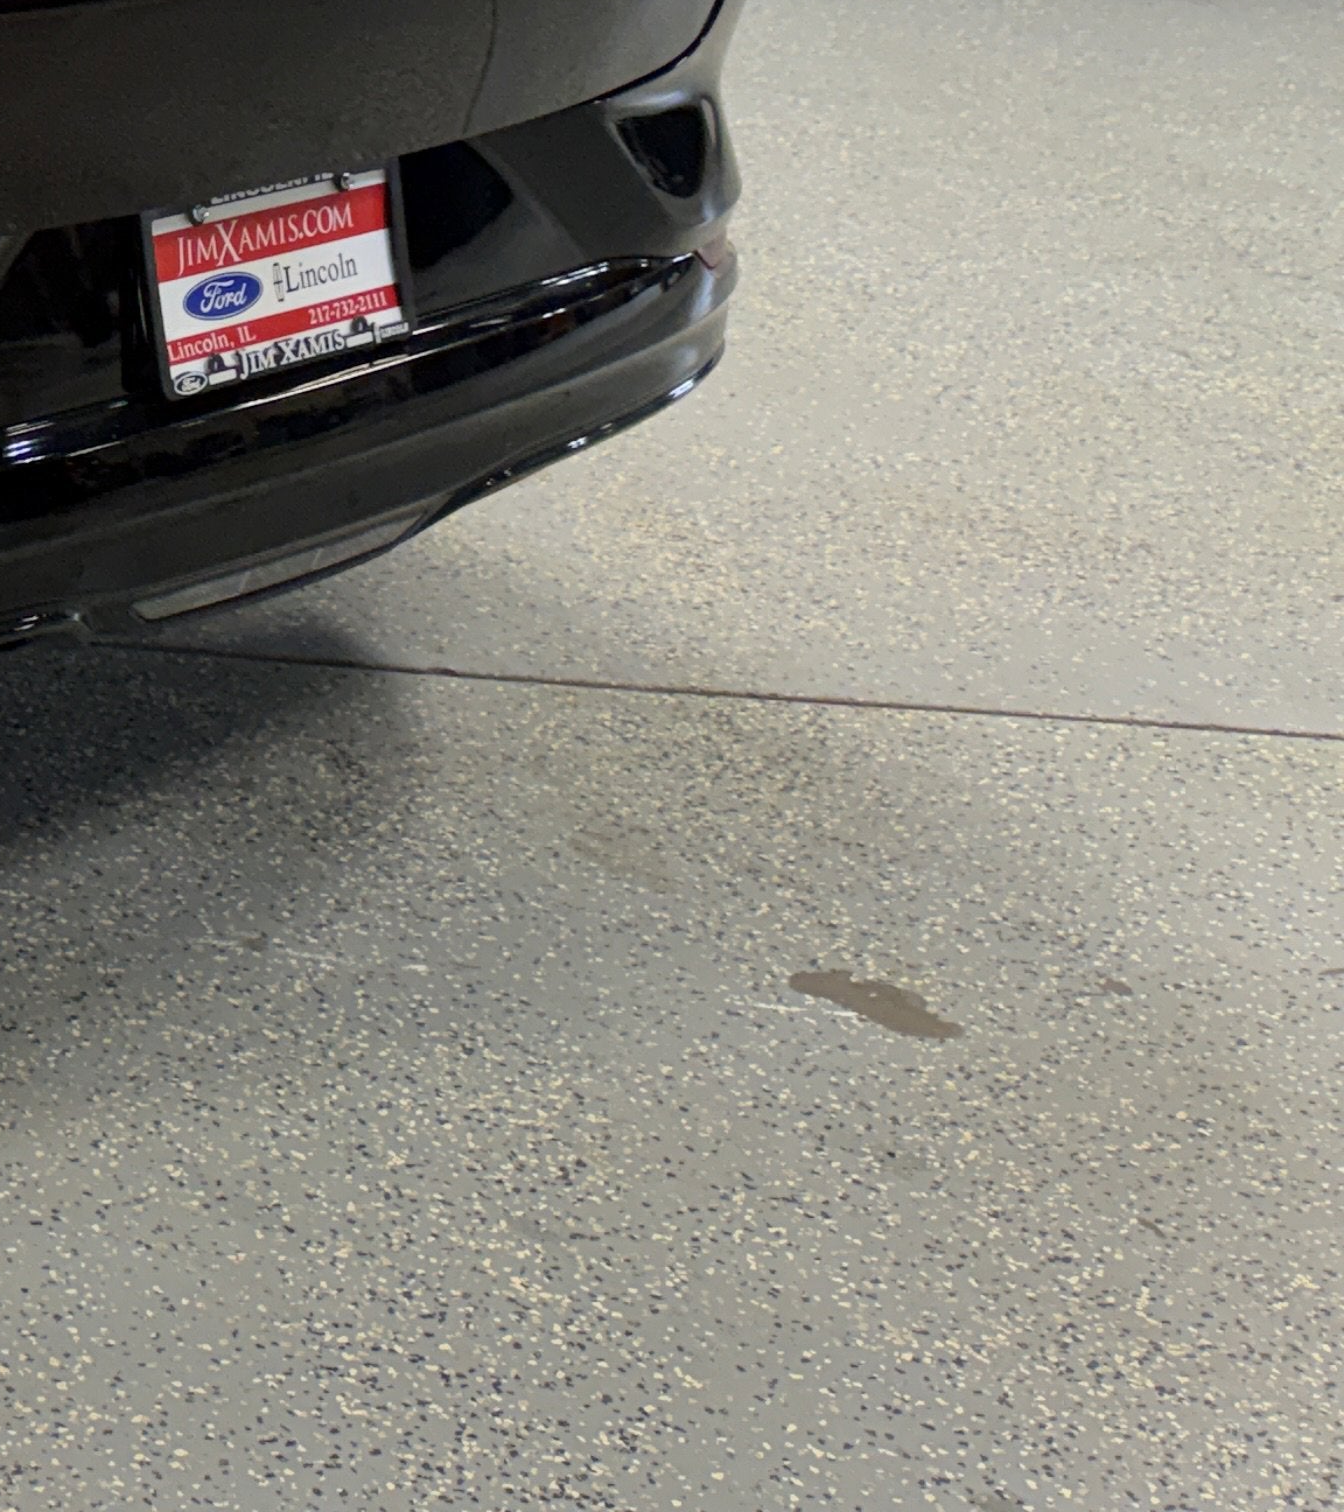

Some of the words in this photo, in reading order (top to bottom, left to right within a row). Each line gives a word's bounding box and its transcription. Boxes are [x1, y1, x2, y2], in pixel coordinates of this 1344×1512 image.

[177, 202, 355, 277] JIMXAMIS.COM
[283, 252, 358, 296] Lincoln
[199, 279, 248, 314] Ford
[308, 291, 388, 326] 217-732-2111
[167, 332, 236, 363] Lincoln,
[237, 326, 257, 346] IL
[240, 347, 280, 380] JIM
[280, 329, 345, 366] XAMIS
